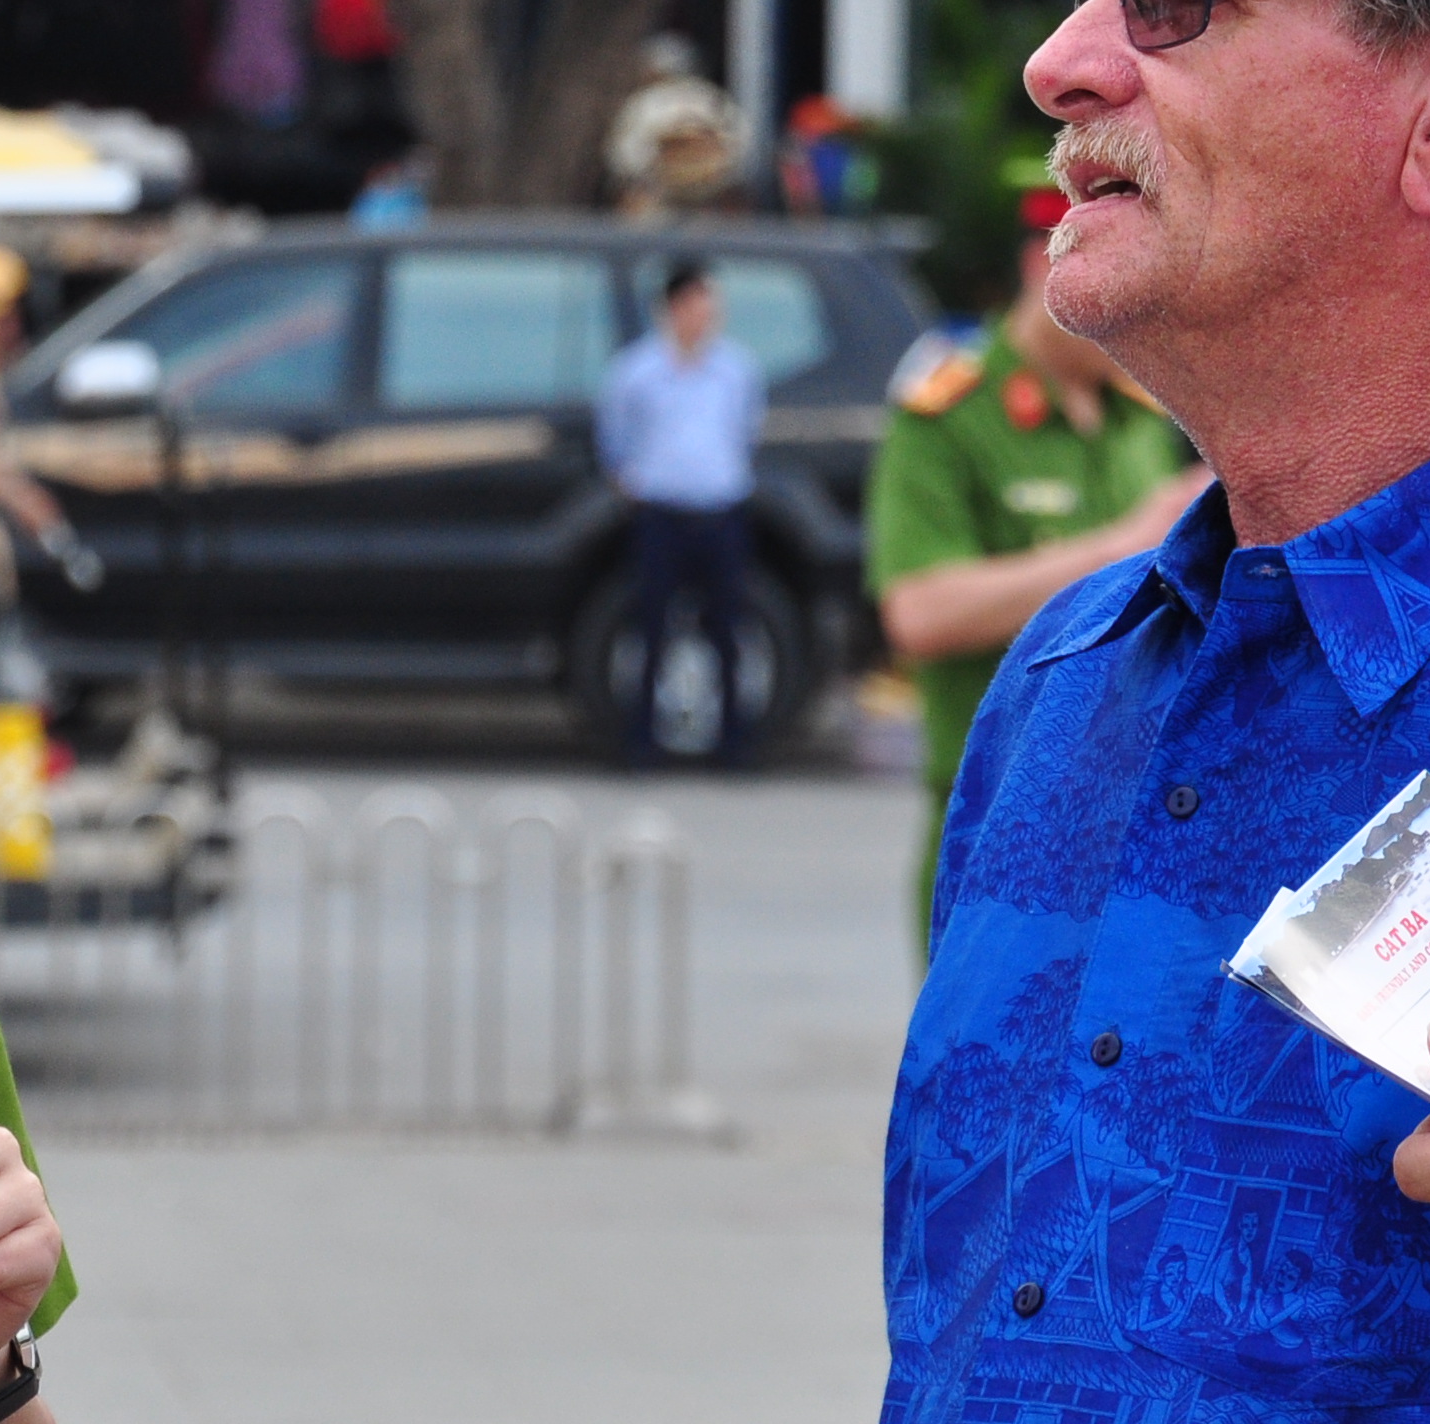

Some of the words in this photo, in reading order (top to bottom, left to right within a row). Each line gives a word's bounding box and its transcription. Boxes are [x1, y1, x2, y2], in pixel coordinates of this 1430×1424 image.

[1374, 928, 1406, 962] CAT
[1399, 910, 1428, 938] BA
[1408, 952, 1428, 974] AND
